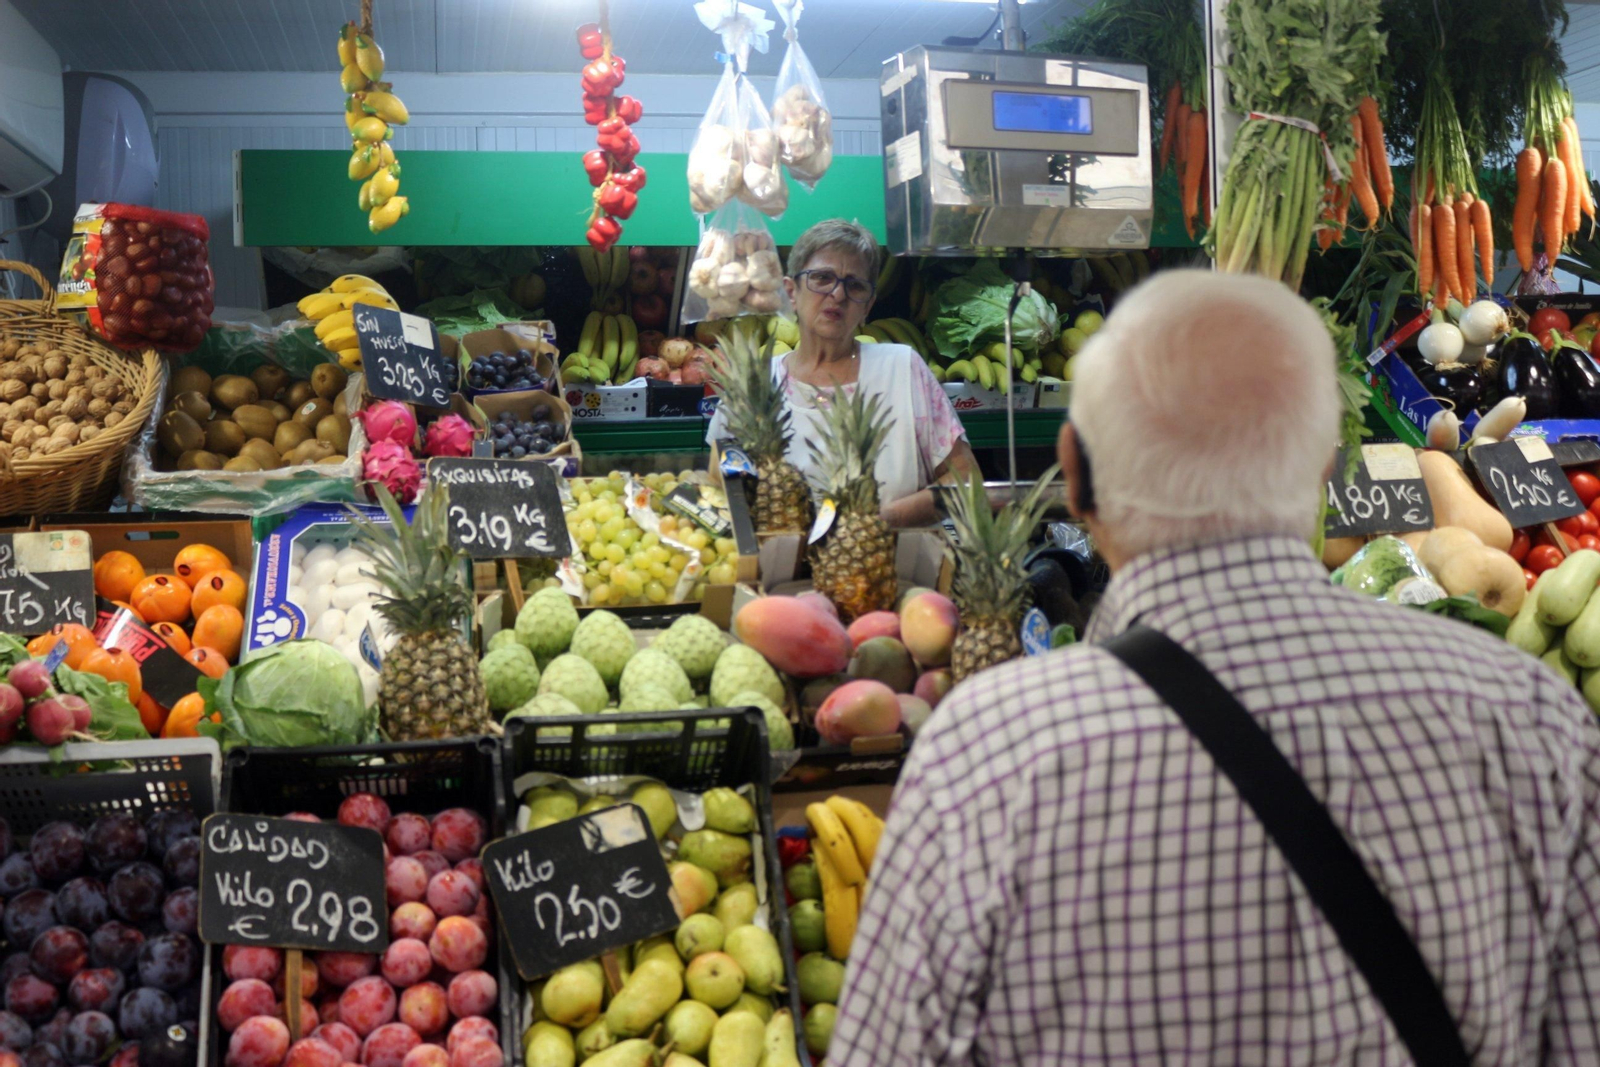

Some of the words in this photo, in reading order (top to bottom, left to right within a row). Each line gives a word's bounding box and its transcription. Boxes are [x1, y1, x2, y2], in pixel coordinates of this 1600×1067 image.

[378, 356, 424, 397] 3.25
[432, 388, 449, 404] €
[1489, 467, 1551, 510] 2.50
[1557, 489, 1576, 508] €
[1530, 467, 1553, 485] KG
[1327, 481, 1390, 526] 1.89
[1390, 484, 1423, 505] KG
[1402, 508, 1429, 524] €
[449, 505, 512, 551] 3.19
[513, 503, 546, 528] KG
[525, 530, 556, 552] €
[493, 849, 554, 891] Kilo
[215, 871, 274, 908] Kilo
[287, 879, 379, 943] 2.98
[228, 915, 270, 939] €
[534, 884, 621, 947] 2.50
[612, 867, 656, 898] €
